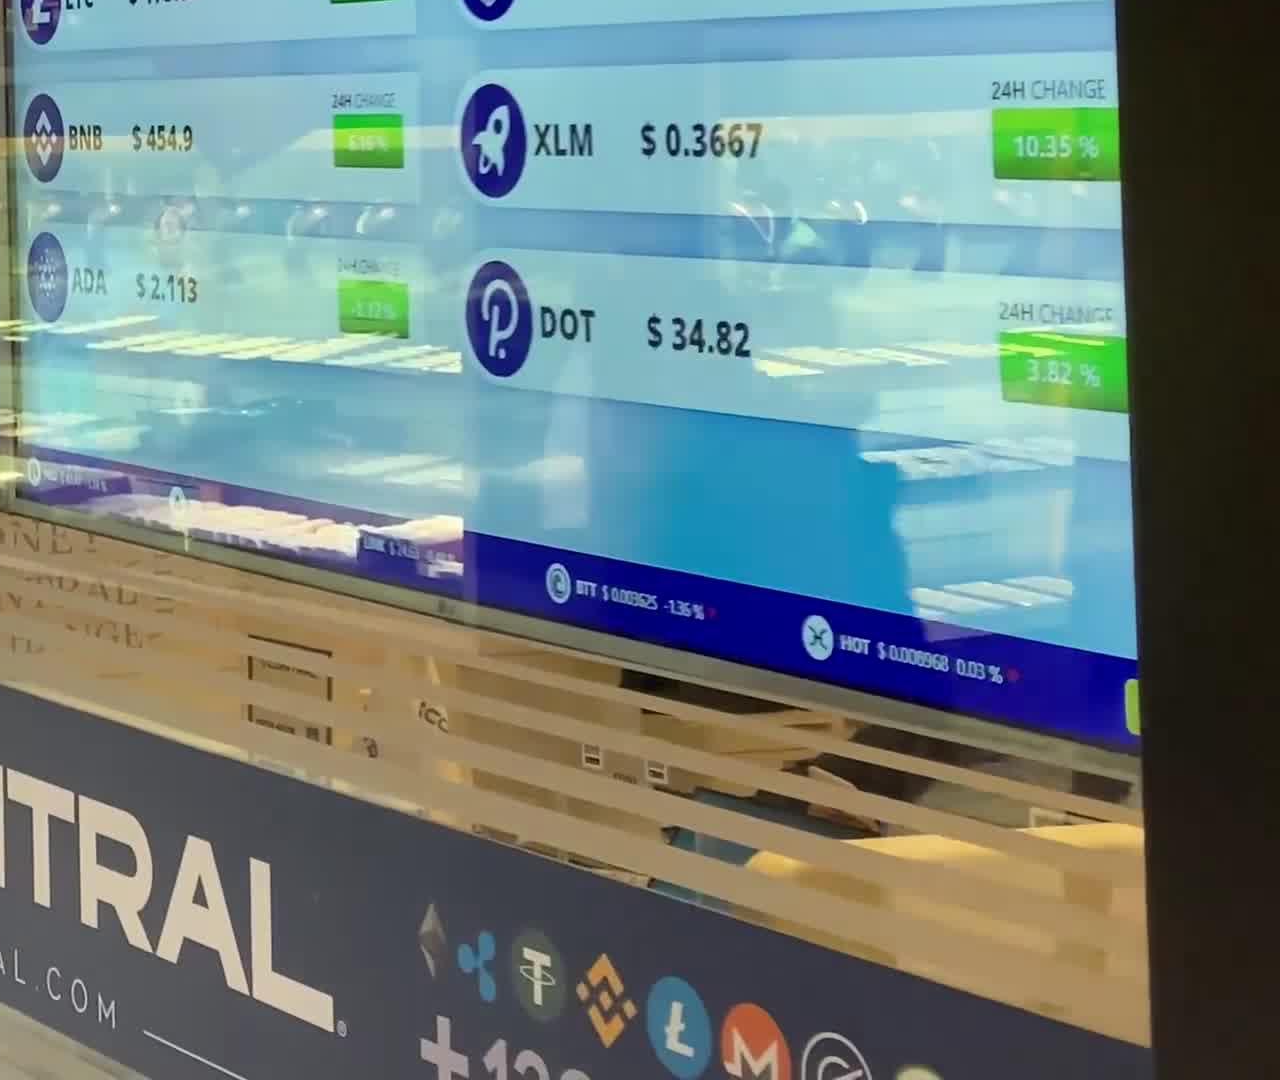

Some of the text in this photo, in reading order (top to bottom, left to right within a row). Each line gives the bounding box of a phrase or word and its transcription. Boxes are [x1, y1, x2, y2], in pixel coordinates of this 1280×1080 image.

[991, 78, 1106, 102] 24H CHANGE
[68, 125, 103, 151] BNB
[146, 125, 193, 152] 454.9
[535, 123, 594, 157] XLM
[665, 123, 763, 158] 0.3667
[1014, 135, 1100, 159] 10.35 %
[72, 268, 107, 295] ADA
[151, 273, 198, 303] 2.113
[999, 301, 1113, 326] 24H CHANGE
[540, 306, 595, 342] DOT
[672, 318, 751, 357] 34.82
[1027, 357, 1074, 385] 3.82
[840, 635, 871, 655] HOT
